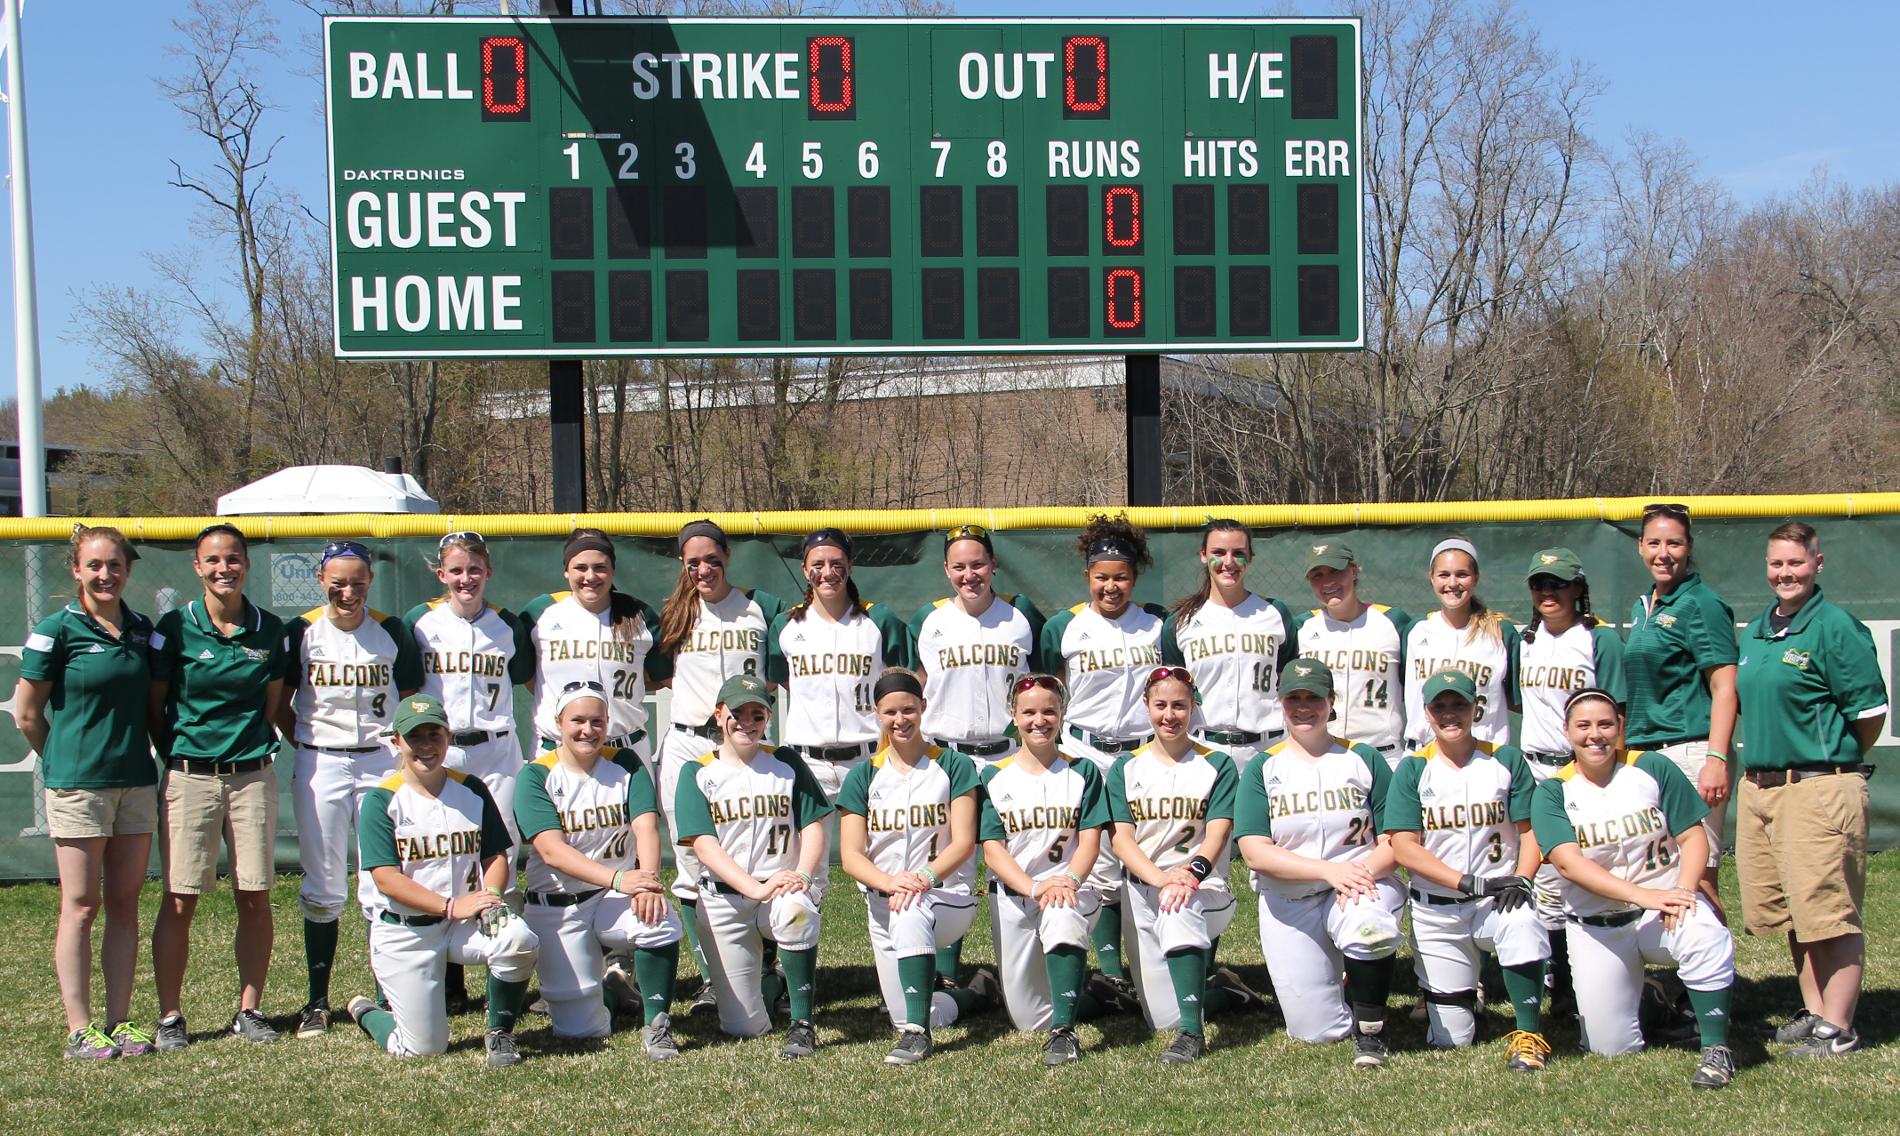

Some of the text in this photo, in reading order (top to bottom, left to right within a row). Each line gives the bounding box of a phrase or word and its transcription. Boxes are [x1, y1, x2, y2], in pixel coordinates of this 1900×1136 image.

[349, 37, 525, 114] BALL 0
[632, 37, 851, 112] STRIKE 0
[958, 37, 1106, 112] OUT 0
[1208, 52, 1284, 103] H/E
[563, 139, 1350, 180] 1 2 3 4 5 6 7 8 RUNS HITS ERR
[343, 169, 465, 181] DAKTRONICS
[347, 191, 526, 249] GUEST
[1106, 187, 1139, 246] 0
[351, 275, 523, 332] HOME
[1107, 269, 1140, 328] 0
[549, 638, 635, 664] FALCONS
[684, 629, 759, 653] ALCONS
[1190, 634, 1275, 662] FALCONS
[424, 651, 506, 678] FALCONS
[792, 652, 872, 677] FALCONS
[939, 644, 1019, 670] FALCONS
[1080, 644, 1162, 672] FALCONS
[308, 663, 390, 688] FALCONS
[612, 669, 637, 700] 20
[1252, 662, 1272, 693] 18
[371, 692, 386, 718] 9
[487, 683, 500, 712] 7
[855, 683, 871, 712] 11
[1364, 679, 1388, 708] 14
[1128, 796, 1208, 822] FALCONS
[1270, 787, 1362, 819] FALCONS
[603, 831, 629, 859] 10
[767, 825, 791, 855] 17
[927, 834, 939, 862] 1
[1047, 836, 1069, 864] 5
[1174, 825, 1196, 854] 2
[1487, 832, 1501, 863] 3
[1645, 835, 1670, 870] 15
[466, 861, 478, 892] 4
